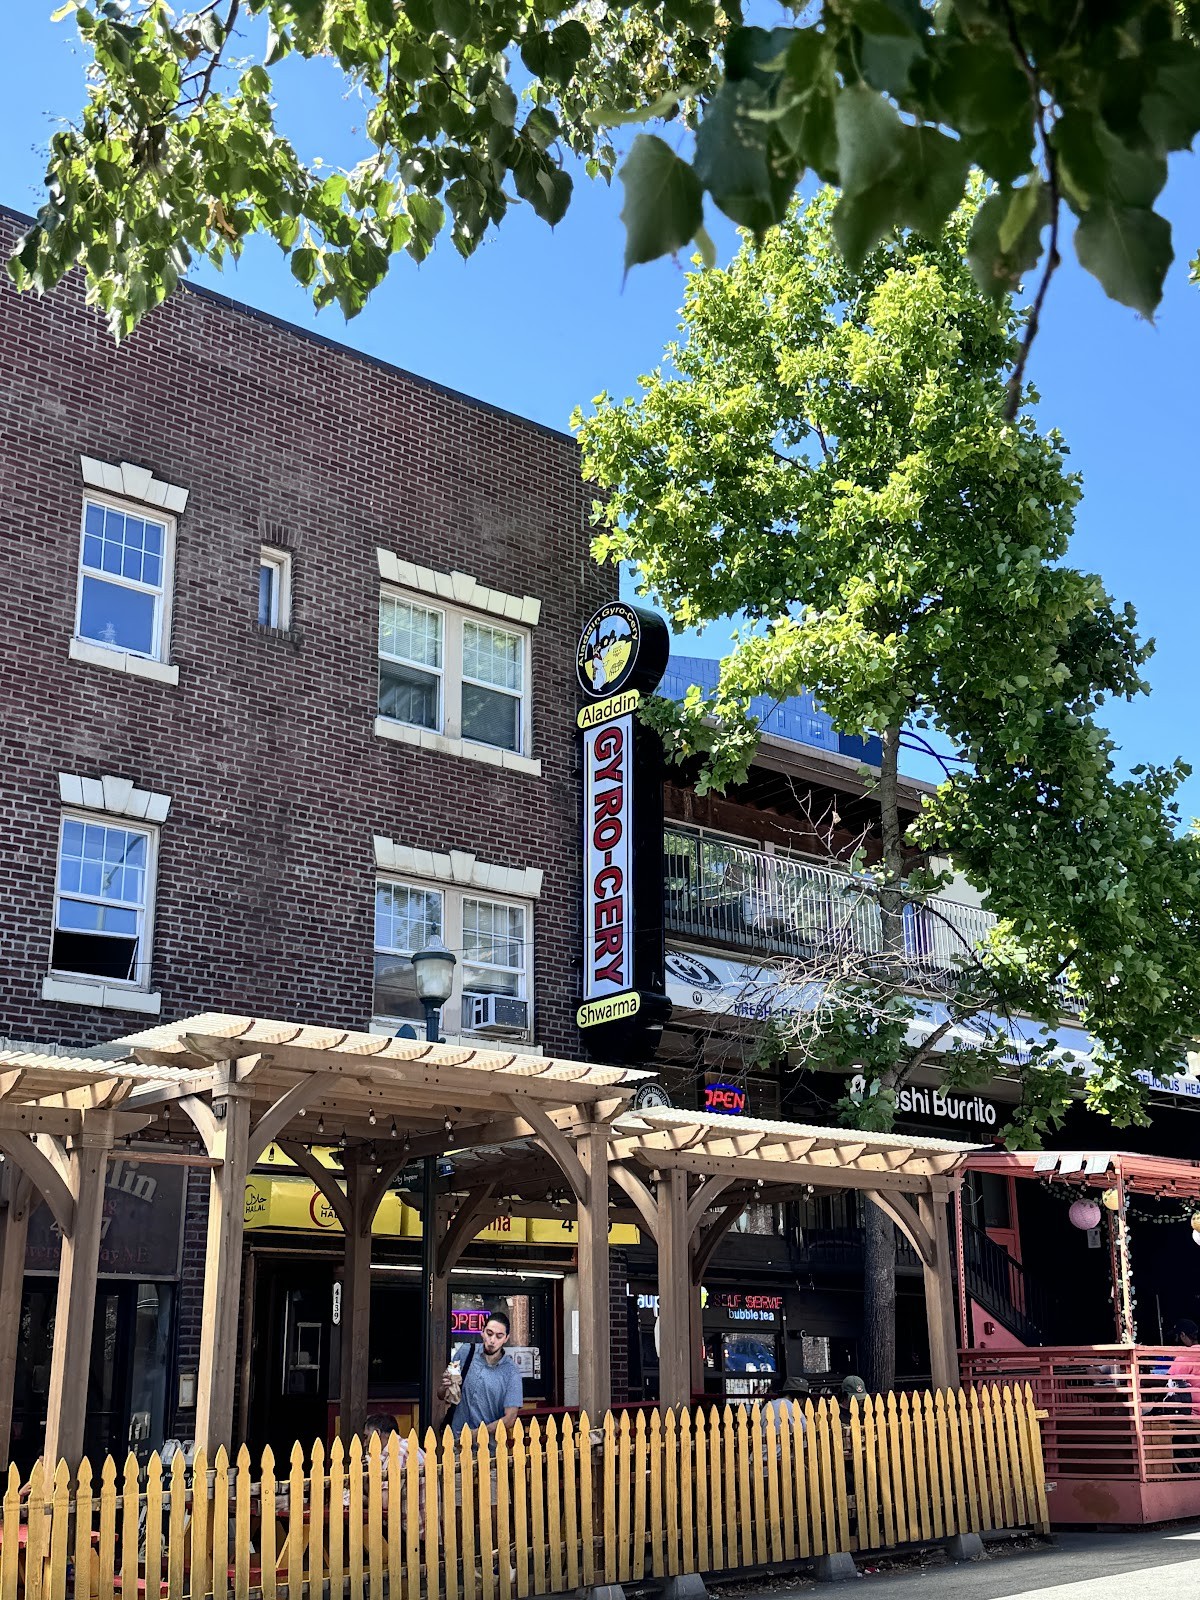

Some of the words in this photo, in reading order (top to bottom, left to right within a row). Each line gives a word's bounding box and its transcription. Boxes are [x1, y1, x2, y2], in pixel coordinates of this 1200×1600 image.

[577, 616, 601, 667] Aladdin
[601, 605, 638, 641] Gyro-Cery
[581, 694, 637, 727] Aladdin
[593, 725, 623, 987] GYRO-CERY
[579, 994, 637, 1026] Shwarma
[933, 1090, 996, 1125] Burrito
[245, 1205, 266, 1214] HALAL
[451, 1313, 489, 1331] OPEN
[728, 1308, 759, 1321] bubble
[760, 1309, 775, 1322] tea
